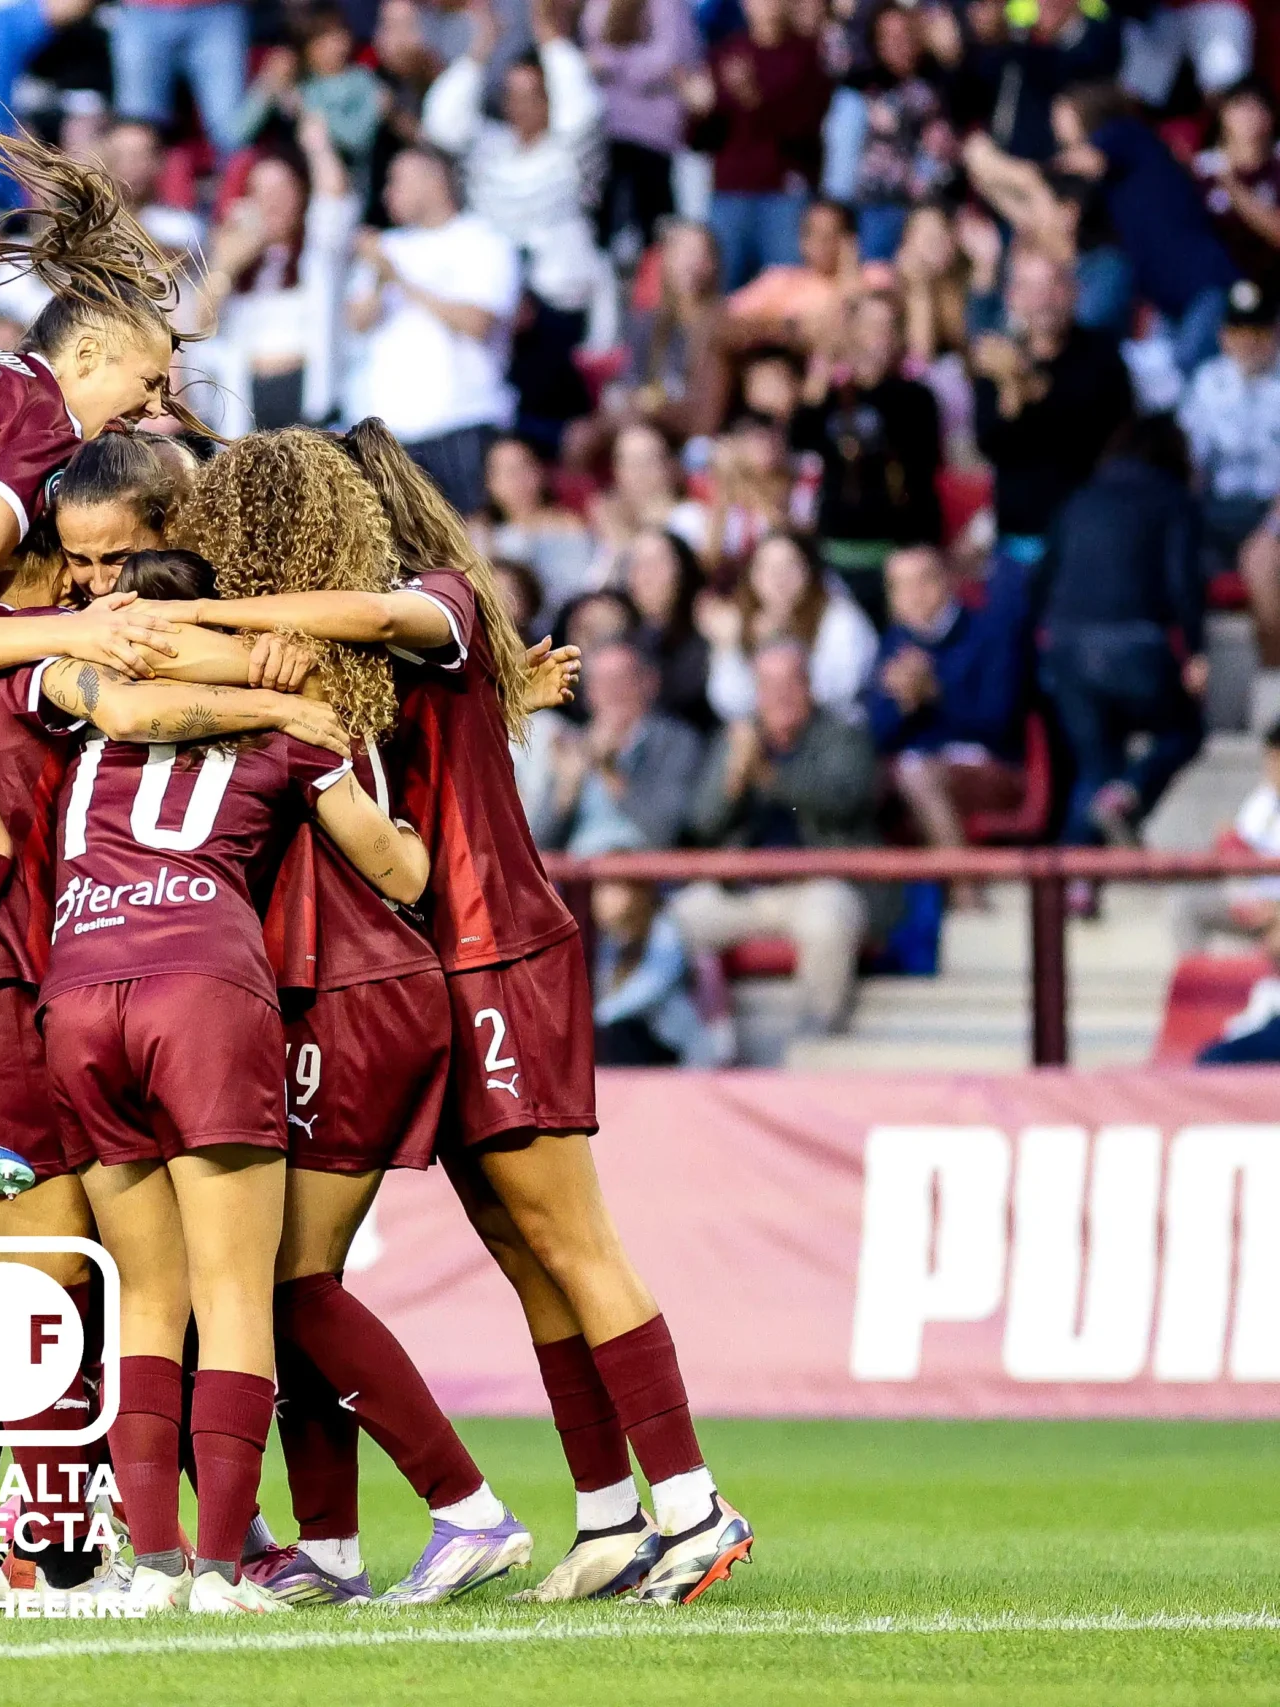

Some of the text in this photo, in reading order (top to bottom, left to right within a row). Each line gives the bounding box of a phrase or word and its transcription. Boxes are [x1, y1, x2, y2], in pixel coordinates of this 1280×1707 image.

[64, 728, 238, 859] 10
[474, 1008, 516, 1073] 2
[286, 1043, 321, 1106] 9
